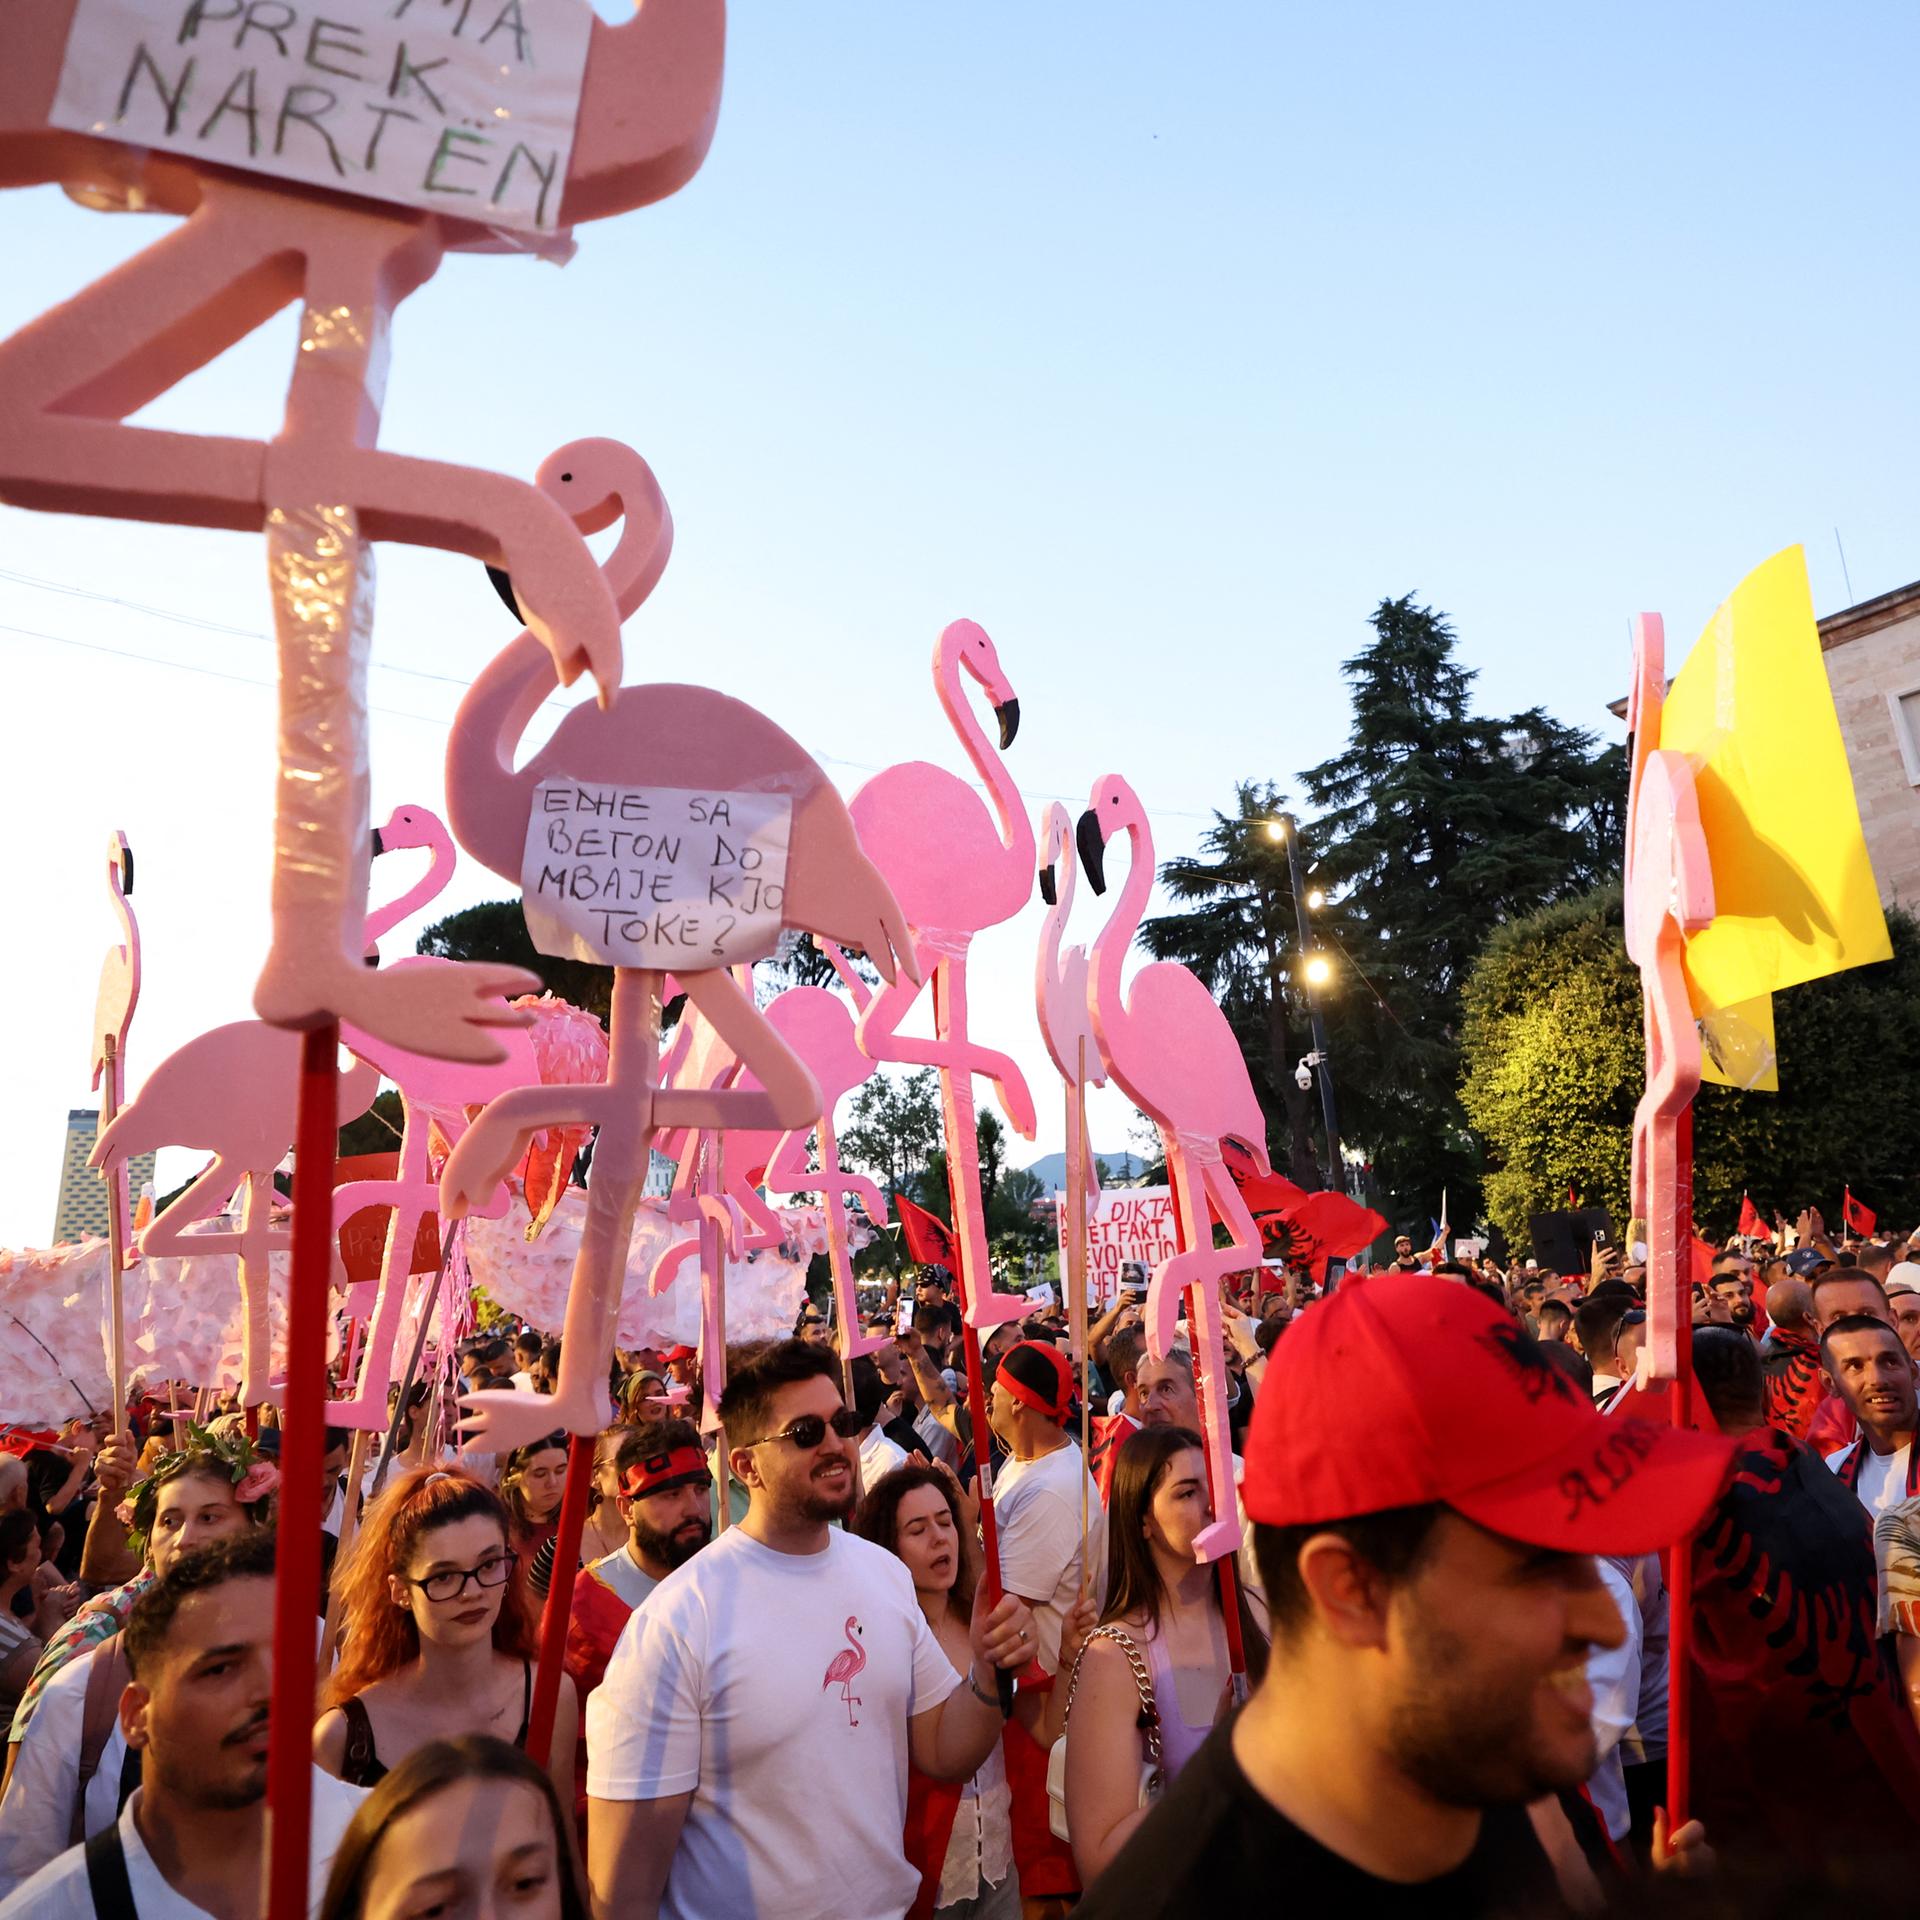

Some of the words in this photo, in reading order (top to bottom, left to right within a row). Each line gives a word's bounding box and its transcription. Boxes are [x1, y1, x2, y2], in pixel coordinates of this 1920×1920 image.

[177, 0, 449, 115] PREK
[117, 41, 558, 228] NARTËN
[543, 788, 650, 821] EDHE
[689, 797, 731, 827] SA
[547, 818, 680, 864] BETON
[710, 834, 763, 871] DO
[538, 865, 673, 903] MBAJE
[708, 875, 784, 915] KJO
[1118, 1219, 1167, 1243] FAKT,
